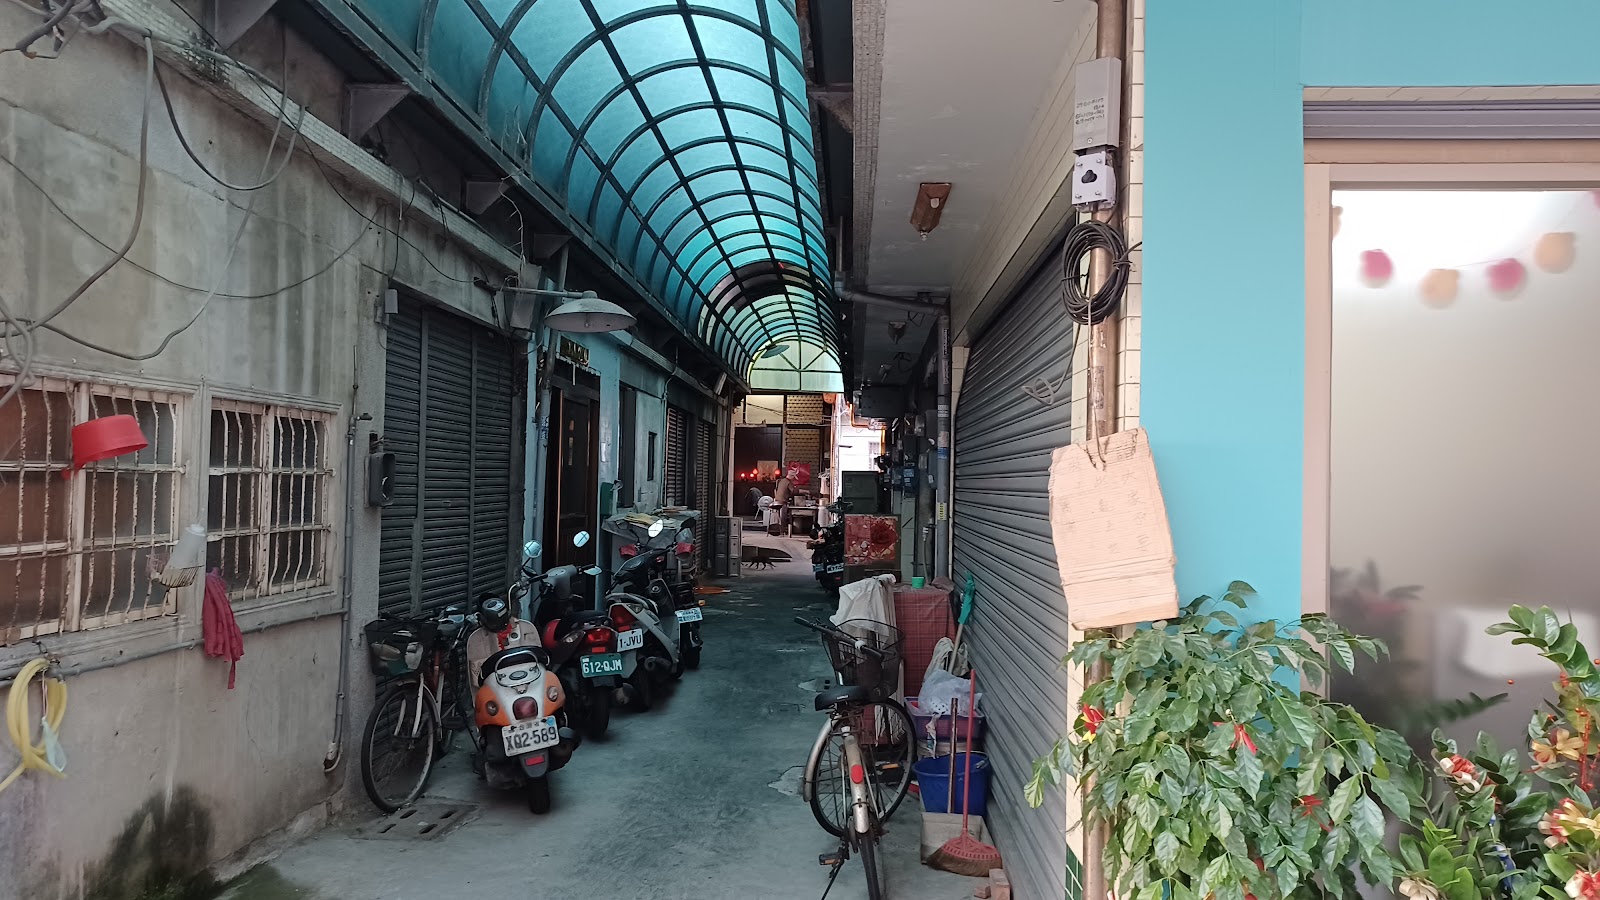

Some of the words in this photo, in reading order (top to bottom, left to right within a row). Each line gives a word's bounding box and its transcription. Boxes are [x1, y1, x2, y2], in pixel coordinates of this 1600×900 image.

[619, 634, 642, 648] 1-JVU
[582, 659, 622, 674] 612-QJM
[505, 726, 557, 751] XQ2-589
